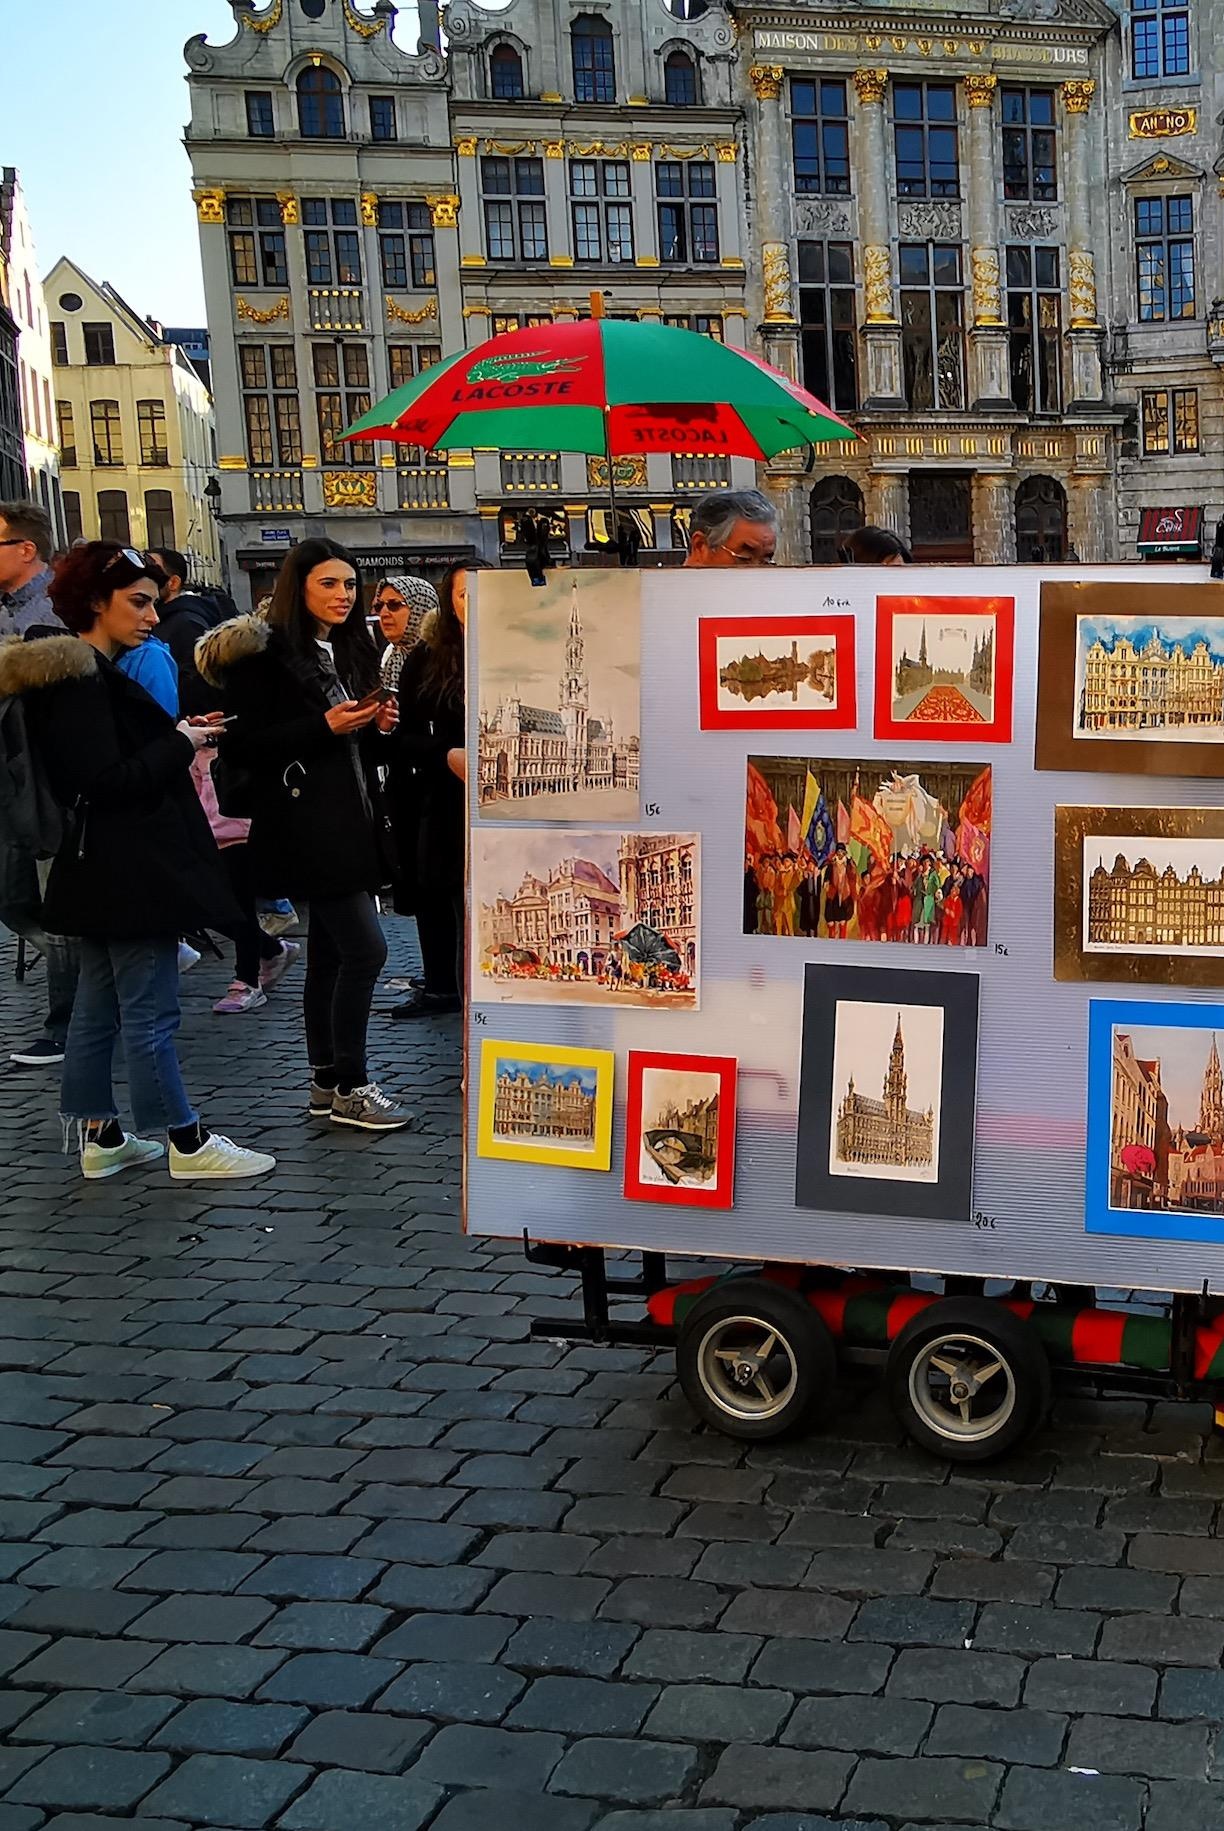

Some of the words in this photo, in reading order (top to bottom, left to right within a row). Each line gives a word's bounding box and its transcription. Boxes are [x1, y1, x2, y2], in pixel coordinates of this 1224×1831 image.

[759, 32, 819, 50] MAISON
[452, 381, 575, 401] LACOSTE
[356, 556, 404, 567] DIAMONDS
